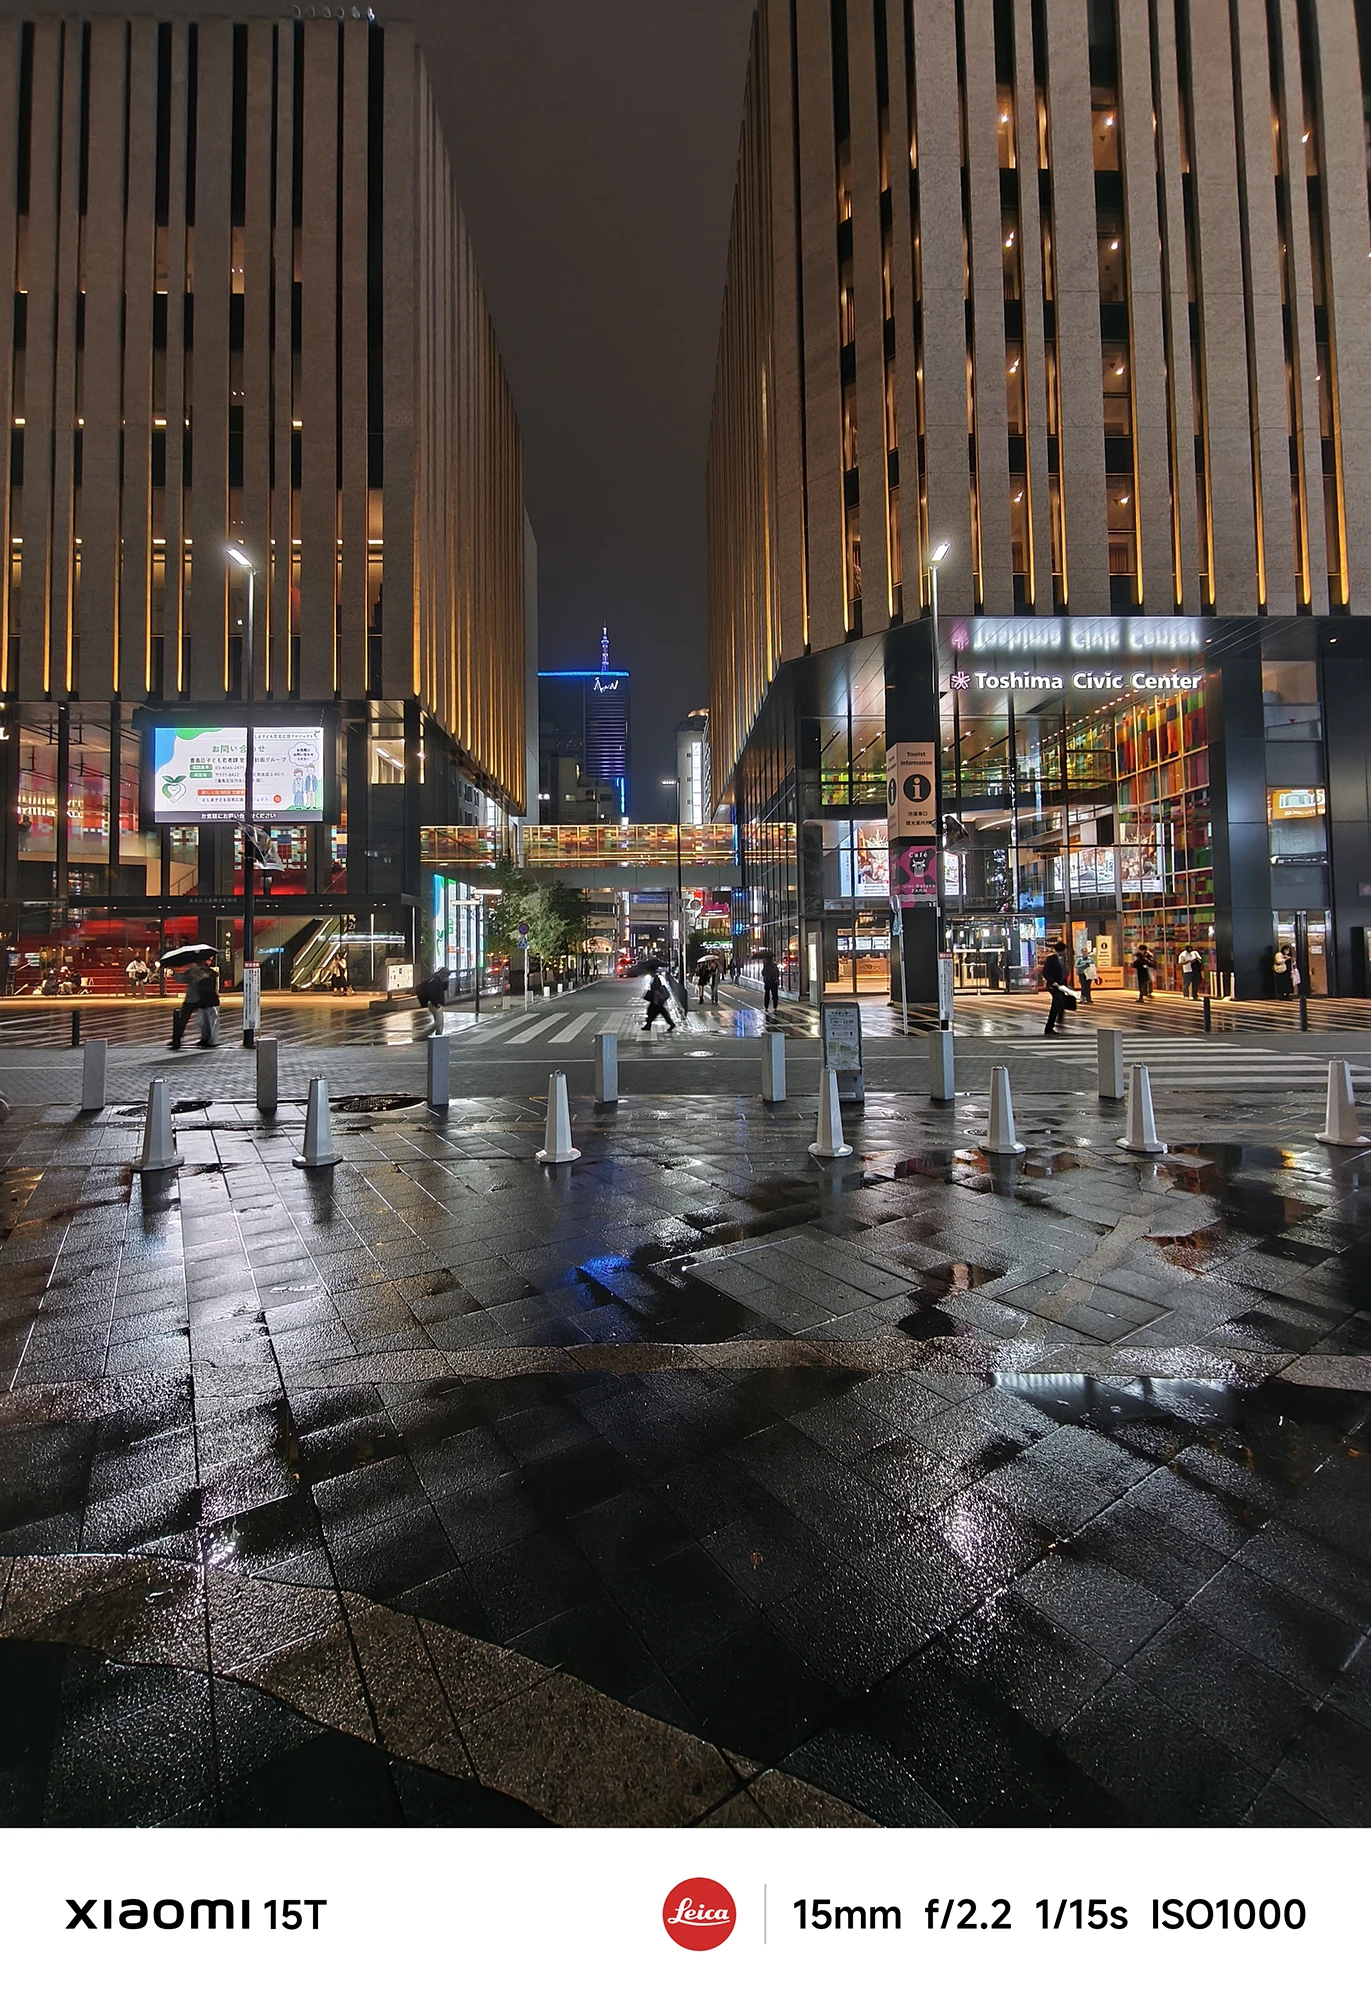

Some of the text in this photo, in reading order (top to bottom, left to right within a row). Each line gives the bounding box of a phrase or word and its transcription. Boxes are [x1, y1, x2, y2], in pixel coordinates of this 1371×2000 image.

[975, 671, 1202, 690] Toshima Civic Center
